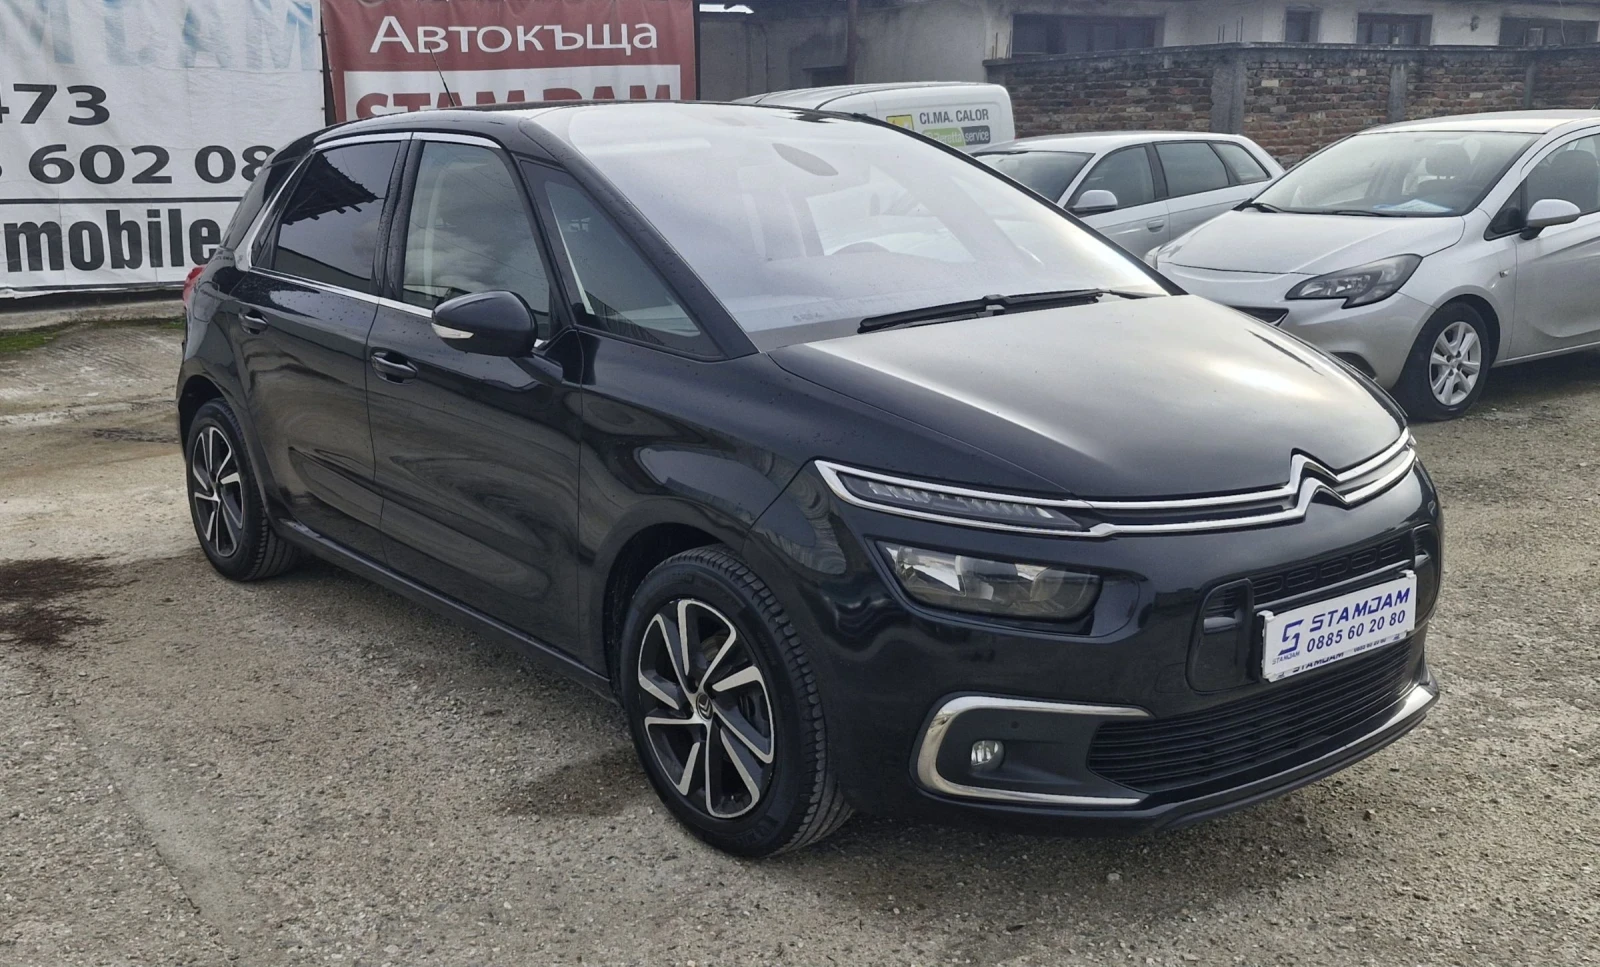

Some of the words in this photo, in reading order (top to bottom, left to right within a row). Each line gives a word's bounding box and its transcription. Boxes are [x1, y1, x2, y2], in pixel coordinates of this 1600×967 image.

[369, 15, 658, 56] Автокъща
[919, 111, 953, 125] CI.MA.
[955, 108, 989, 122] CALOR
[964, 129, 989, 142] service
[28, 144, 172, 184] 602
[3, 208, 221, 273] mobile
[1309, 587, 1411, 633] STAMDAM
[1306, 629, 1343, 653] 0885
[1347, 622, 1364, 640] 60
[1368, 615, 1385, 634] 20
[1389, 609, 1406, 626] 80
